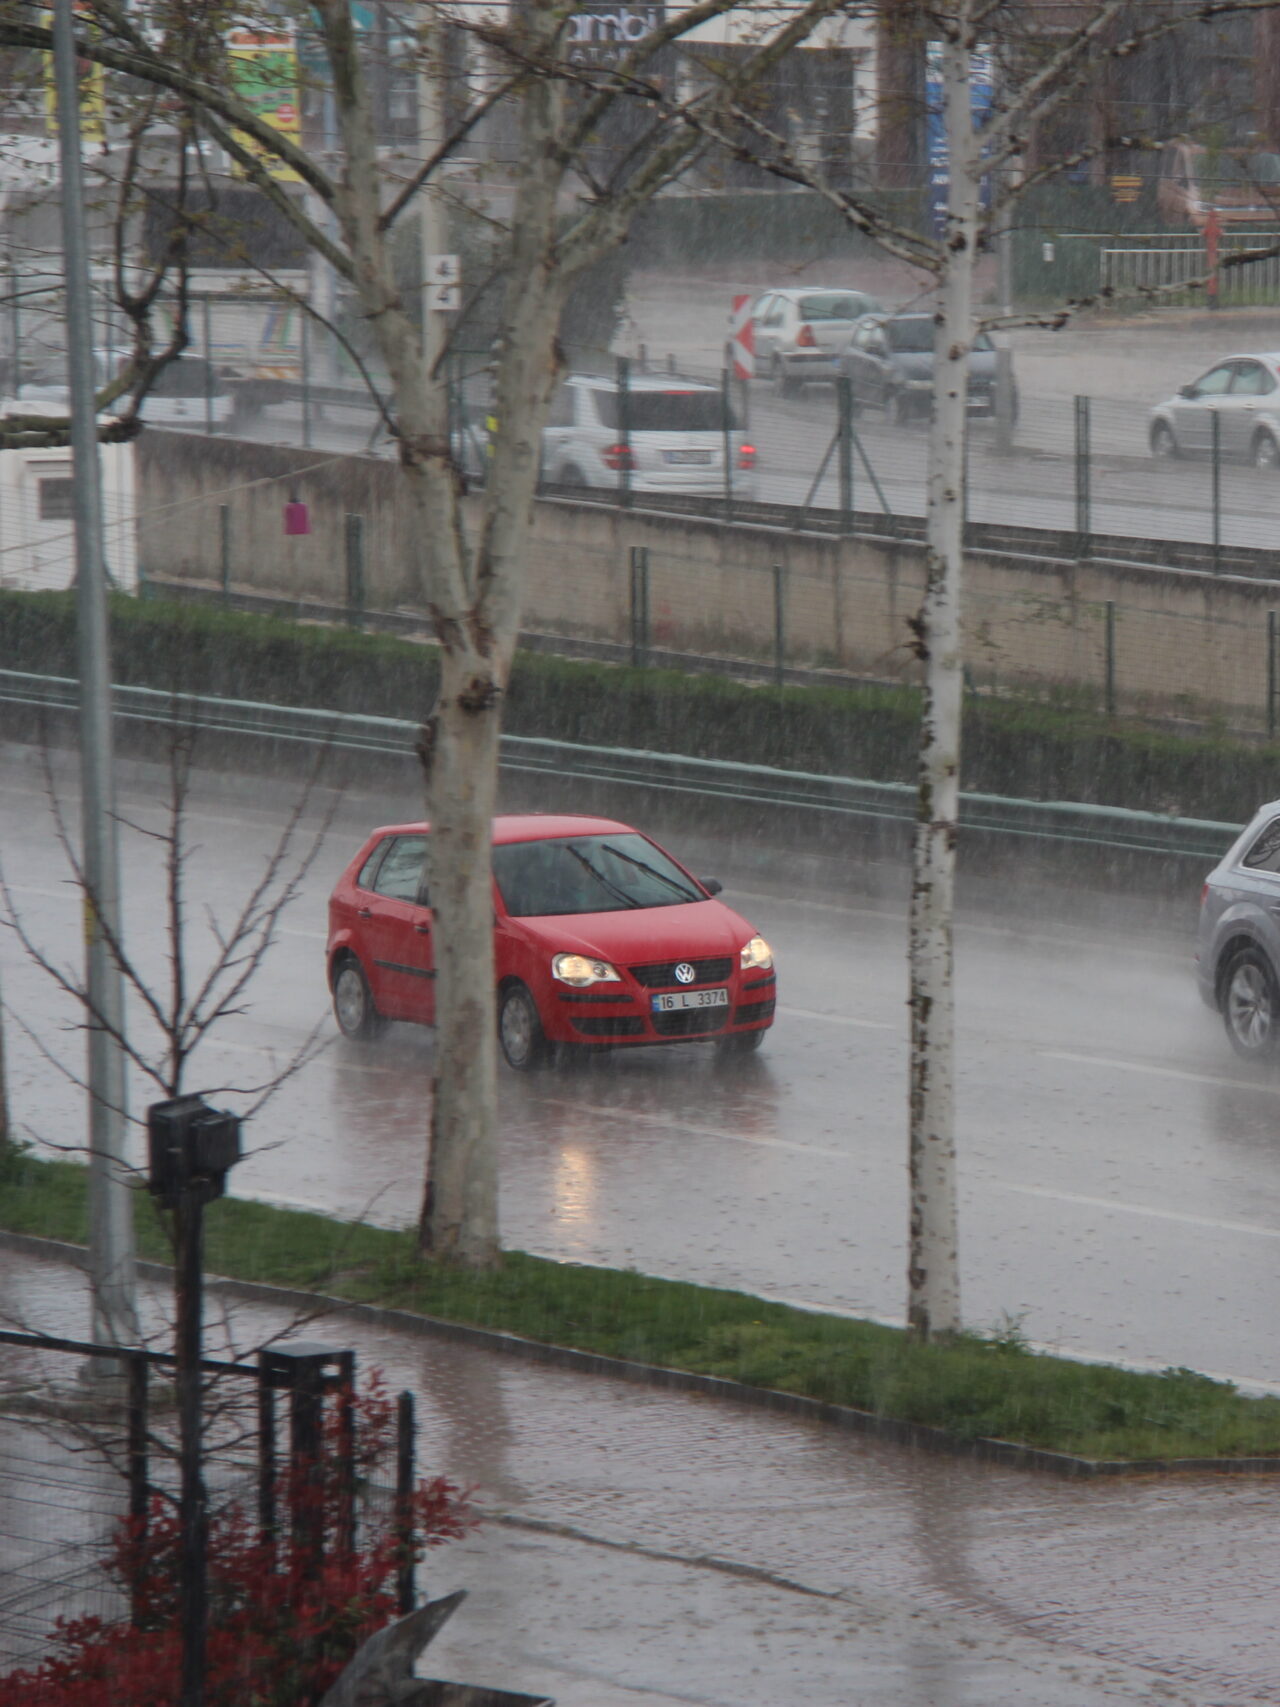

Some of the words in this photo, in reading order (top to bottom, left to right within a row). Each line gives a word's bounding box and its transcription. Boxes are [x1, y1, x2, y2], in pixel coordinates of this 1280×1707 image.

[566, 7, 658, 41] ambi
[661, 996, 674, 1010] 16
[681, 995, 690, 1007] L
[697, 990, 726, 1006] 3374
